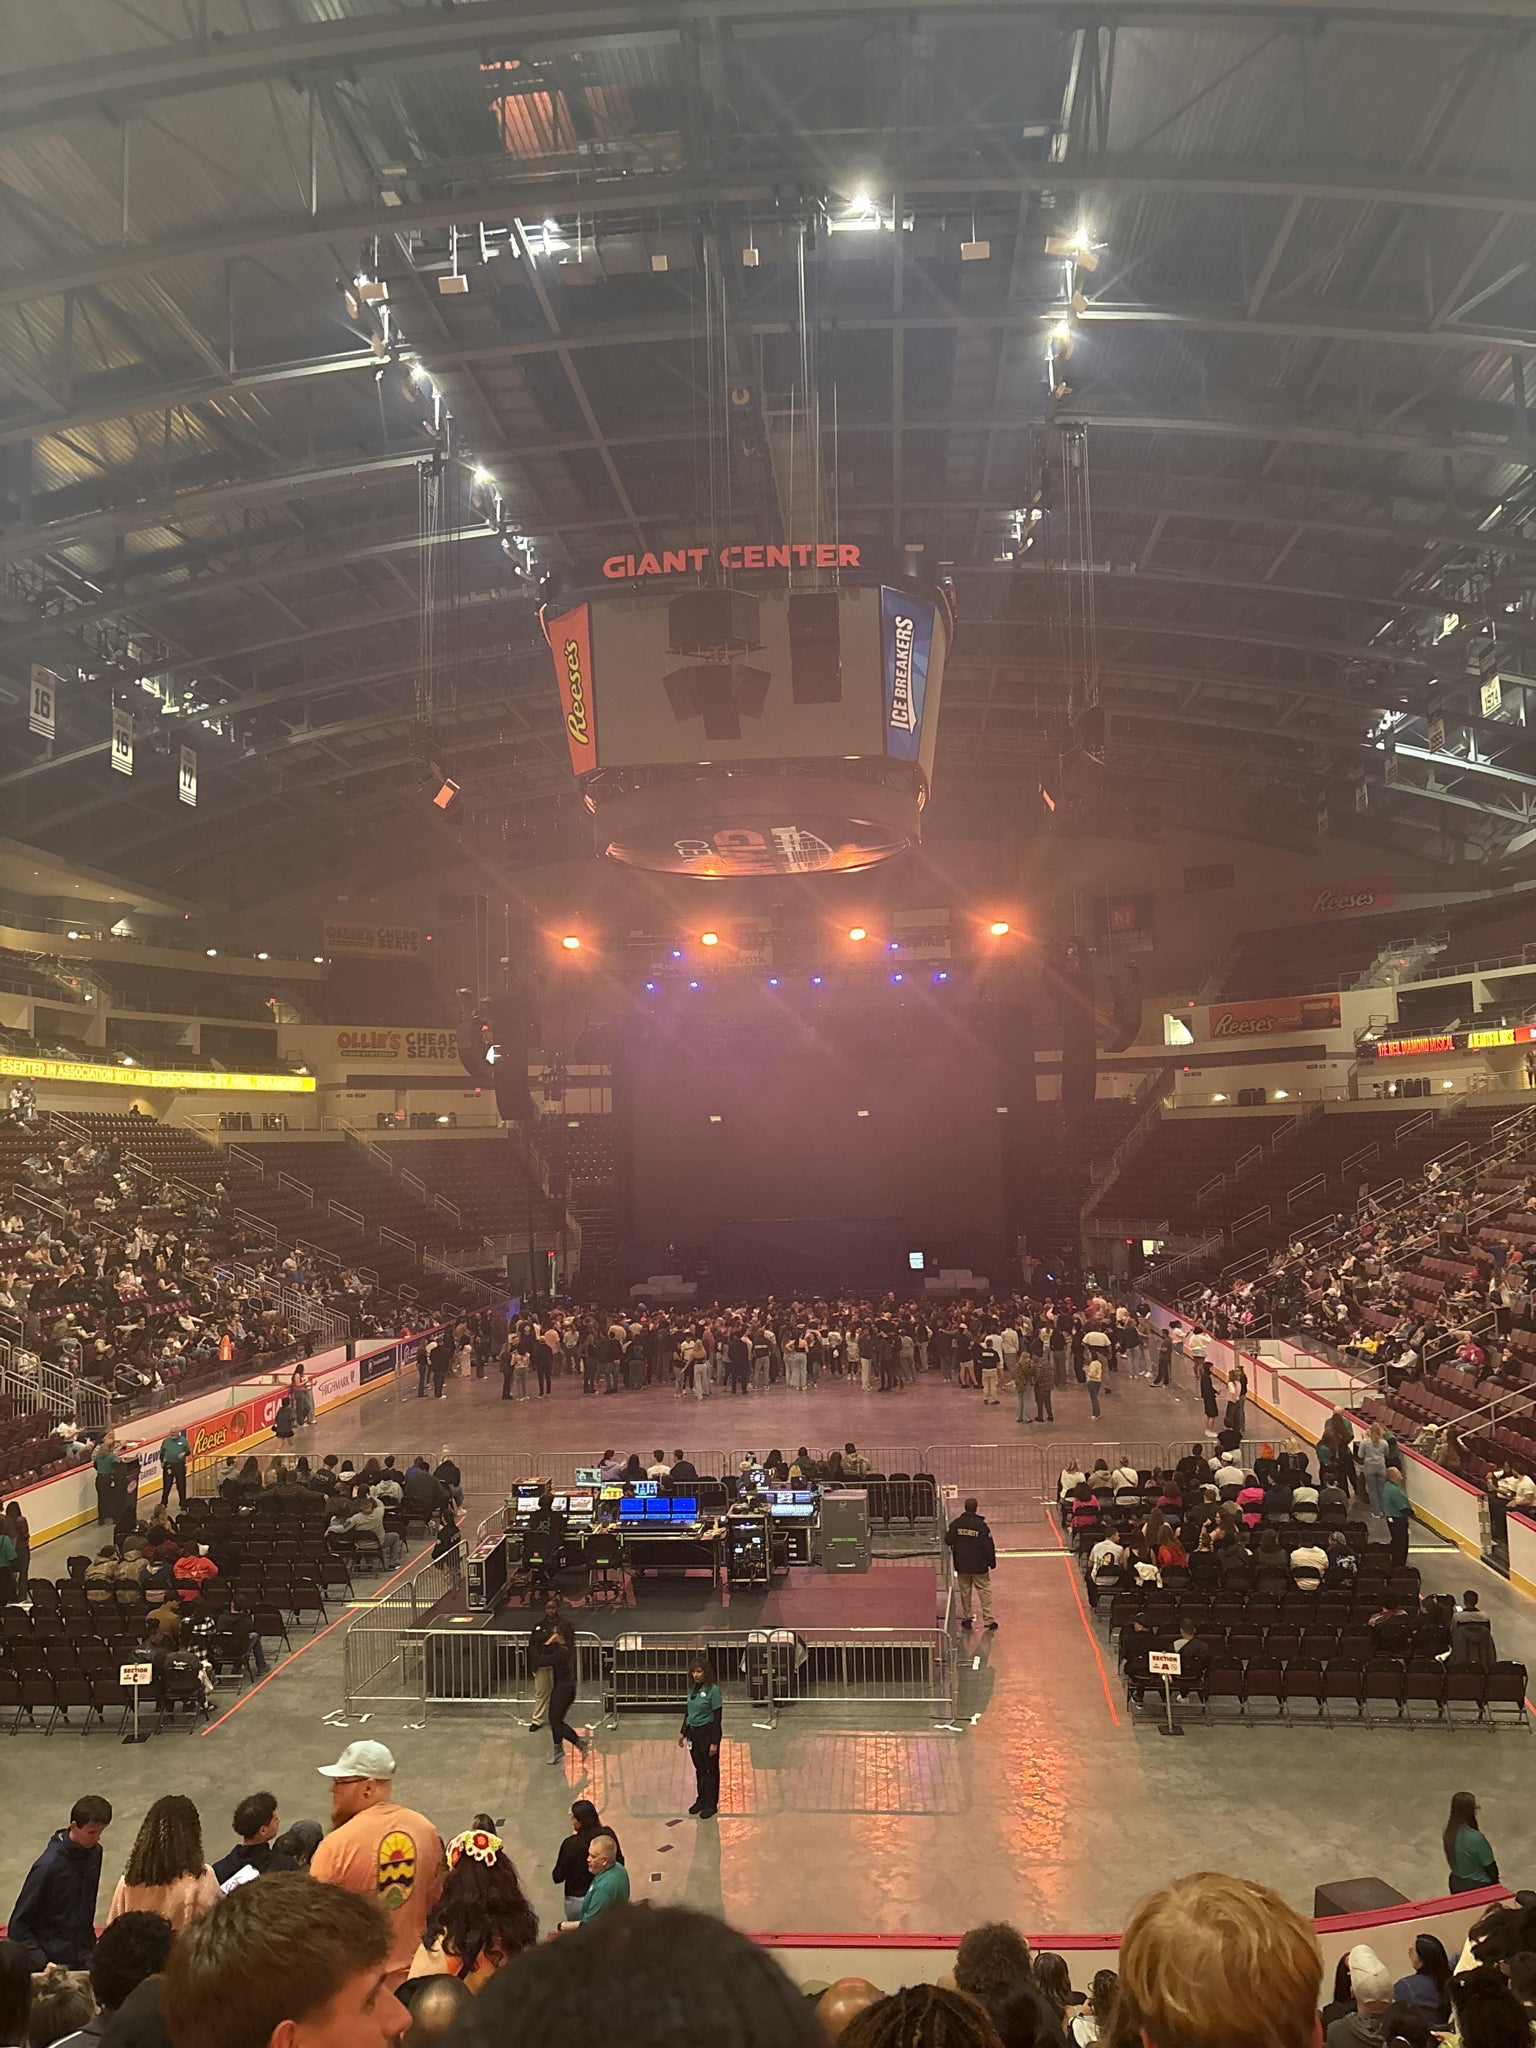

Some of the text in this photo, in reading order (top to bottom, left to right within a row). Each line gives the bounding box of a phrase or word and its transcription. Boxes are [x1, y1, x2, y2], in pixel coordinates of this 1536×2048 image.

[603, 544, 861, 578] GIANT CENTER
[890, 615, 914, 730] ICE BREAKERS
[34, 688, 51, 719] 16
[565, 639, 589, 745] Reese's
[115, 729, 129, 757] 16
[183, 764, 194, 789] 17
[1213, 1012, 1276, 1037] Reese's
[405, 1032, 457, 1046] CHEAP
[407, 1045, 458, 1059] SEATS
[46, 1063, 56, 1076] IN
[58, 1064, 114, 1081] ASSOCIATION
[115, 1071, 133, 1082] WITH
[319, 1376, 351, 1397] HIGHMARK
[264, 1398, 282, 1422] GIA
[192, 1427, 227, 1456] Reese's
[957, 1528, 979, 1537] SECURITY
[133, 1673, 138, 1682] C
